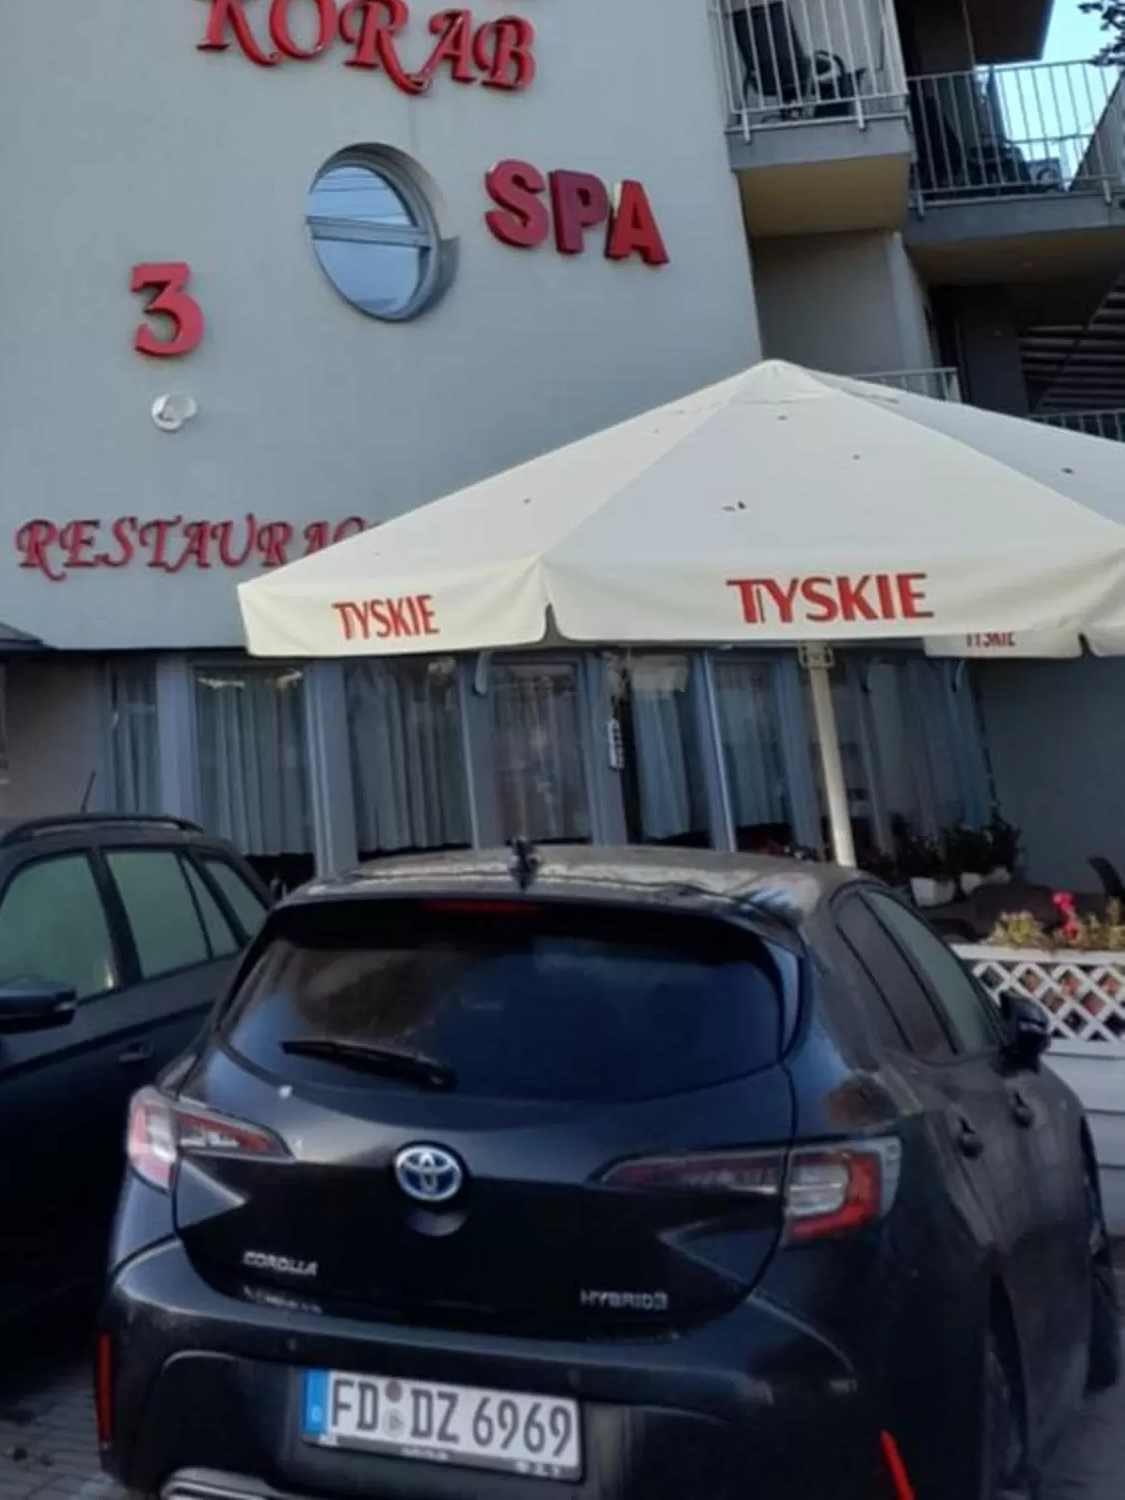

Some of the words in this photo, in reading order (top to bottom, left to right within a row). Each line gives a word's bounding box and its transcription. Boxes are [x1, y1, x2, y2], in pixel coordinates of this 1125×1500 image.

[484, 158, 669, 266] SPA
[129, 261, 205, 357] 3
[332, 594, 440, 640] TYSKIE
[726, 573, 935, 624] TYSKIE
[243, 1251, 318, 1277] COROLLA
[331, 1378, 380, 1431] FD
[410, 1387, 460, 1444] DZ
[472, 1396, 573, 1457] 6969
